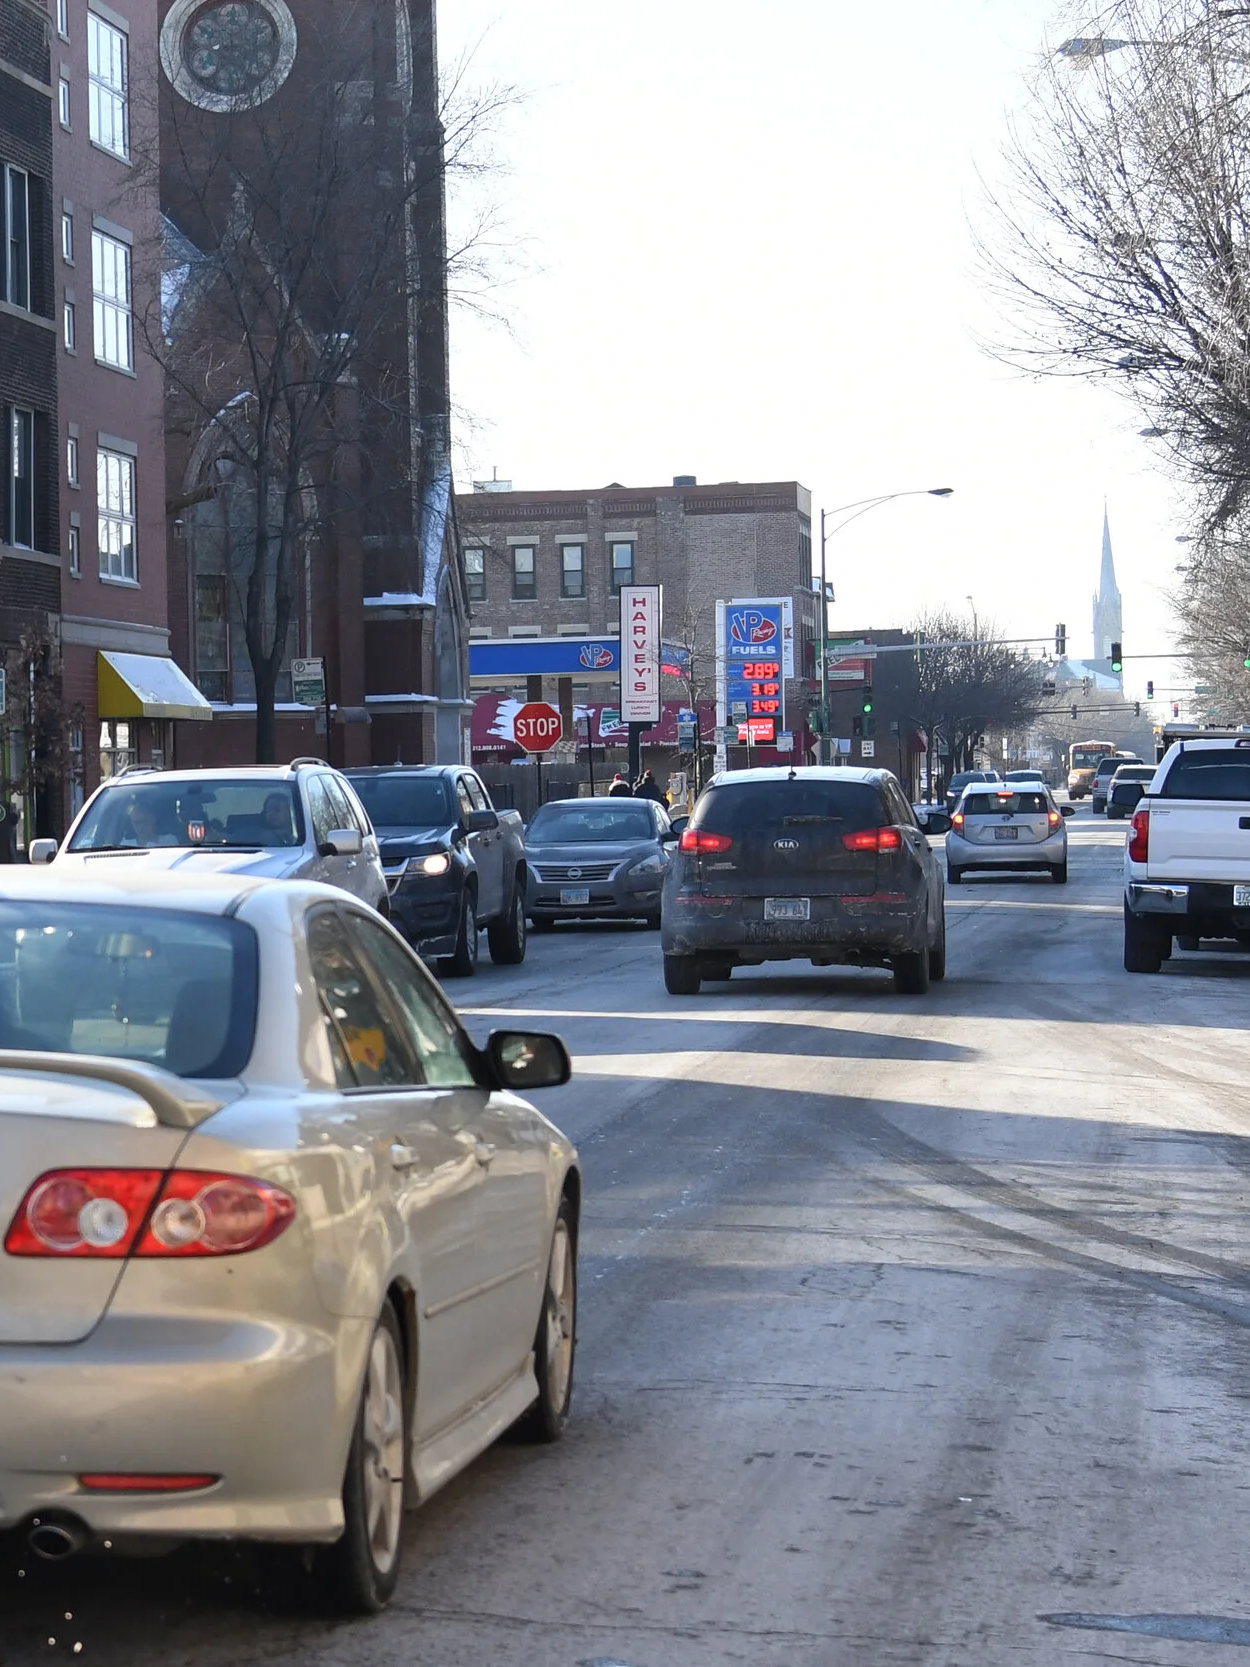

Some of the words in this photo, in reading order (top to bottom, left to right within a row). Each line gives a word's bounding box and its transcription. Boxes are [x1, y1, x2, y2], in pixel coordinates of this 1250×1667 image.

[632, 597, 652, 692] HARVEY'S
[731, 646, 776, 654] FUELS
[516, 717, 559, 737] STOP
[777, 841, 795, 849] KIA
